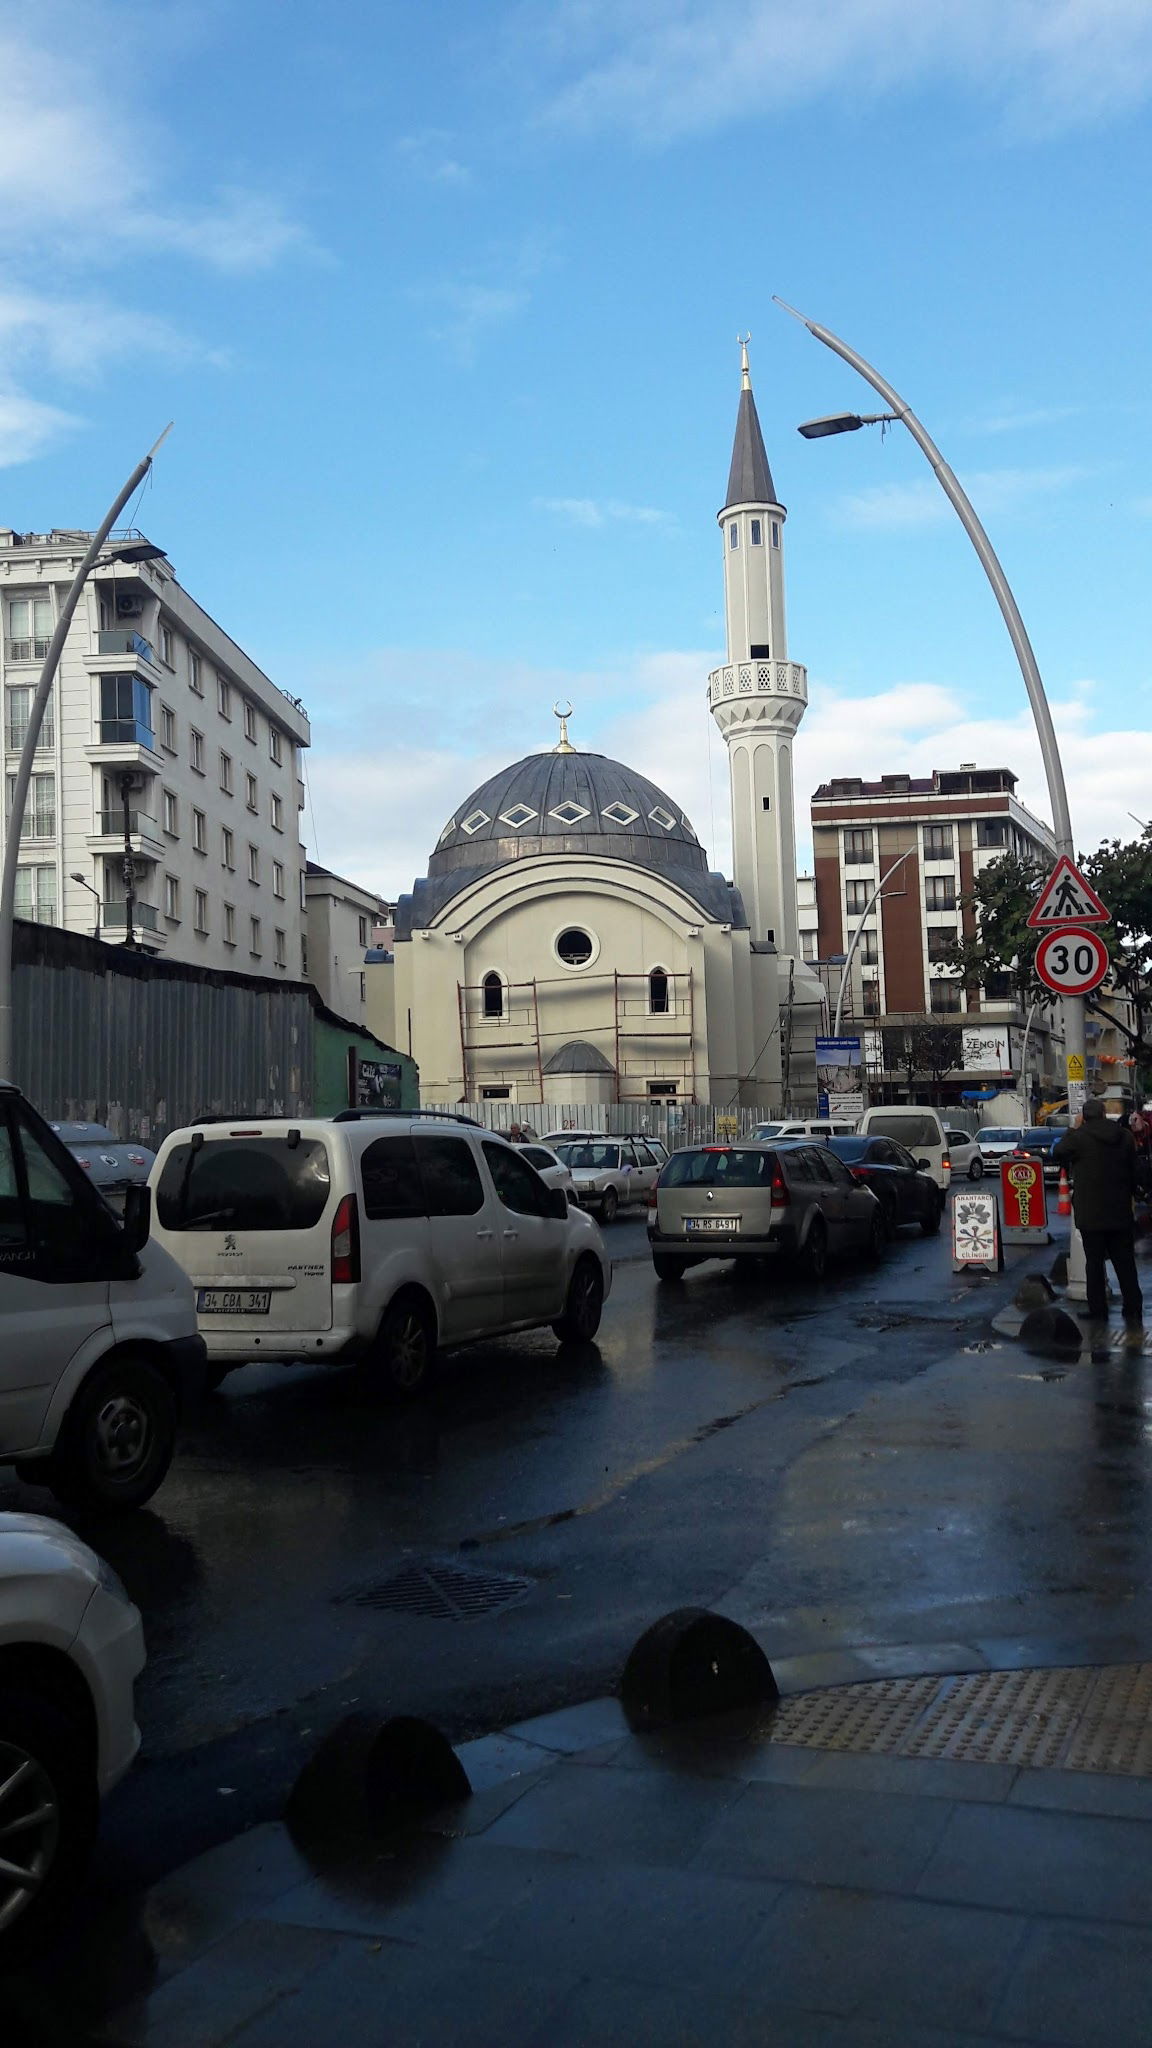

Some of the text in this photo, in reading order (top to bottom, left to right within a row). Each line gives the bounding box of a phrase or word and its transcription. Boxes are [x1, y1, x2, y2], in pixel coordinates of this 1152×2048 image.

[1051, 945, 1093, 976] 30
[966, 1038, 1005, 1049] ZENGİN
[691, 1218, 734, 1229] 34 RS 6491
[205, 1294, 267, 1308] 34 CBA 341
